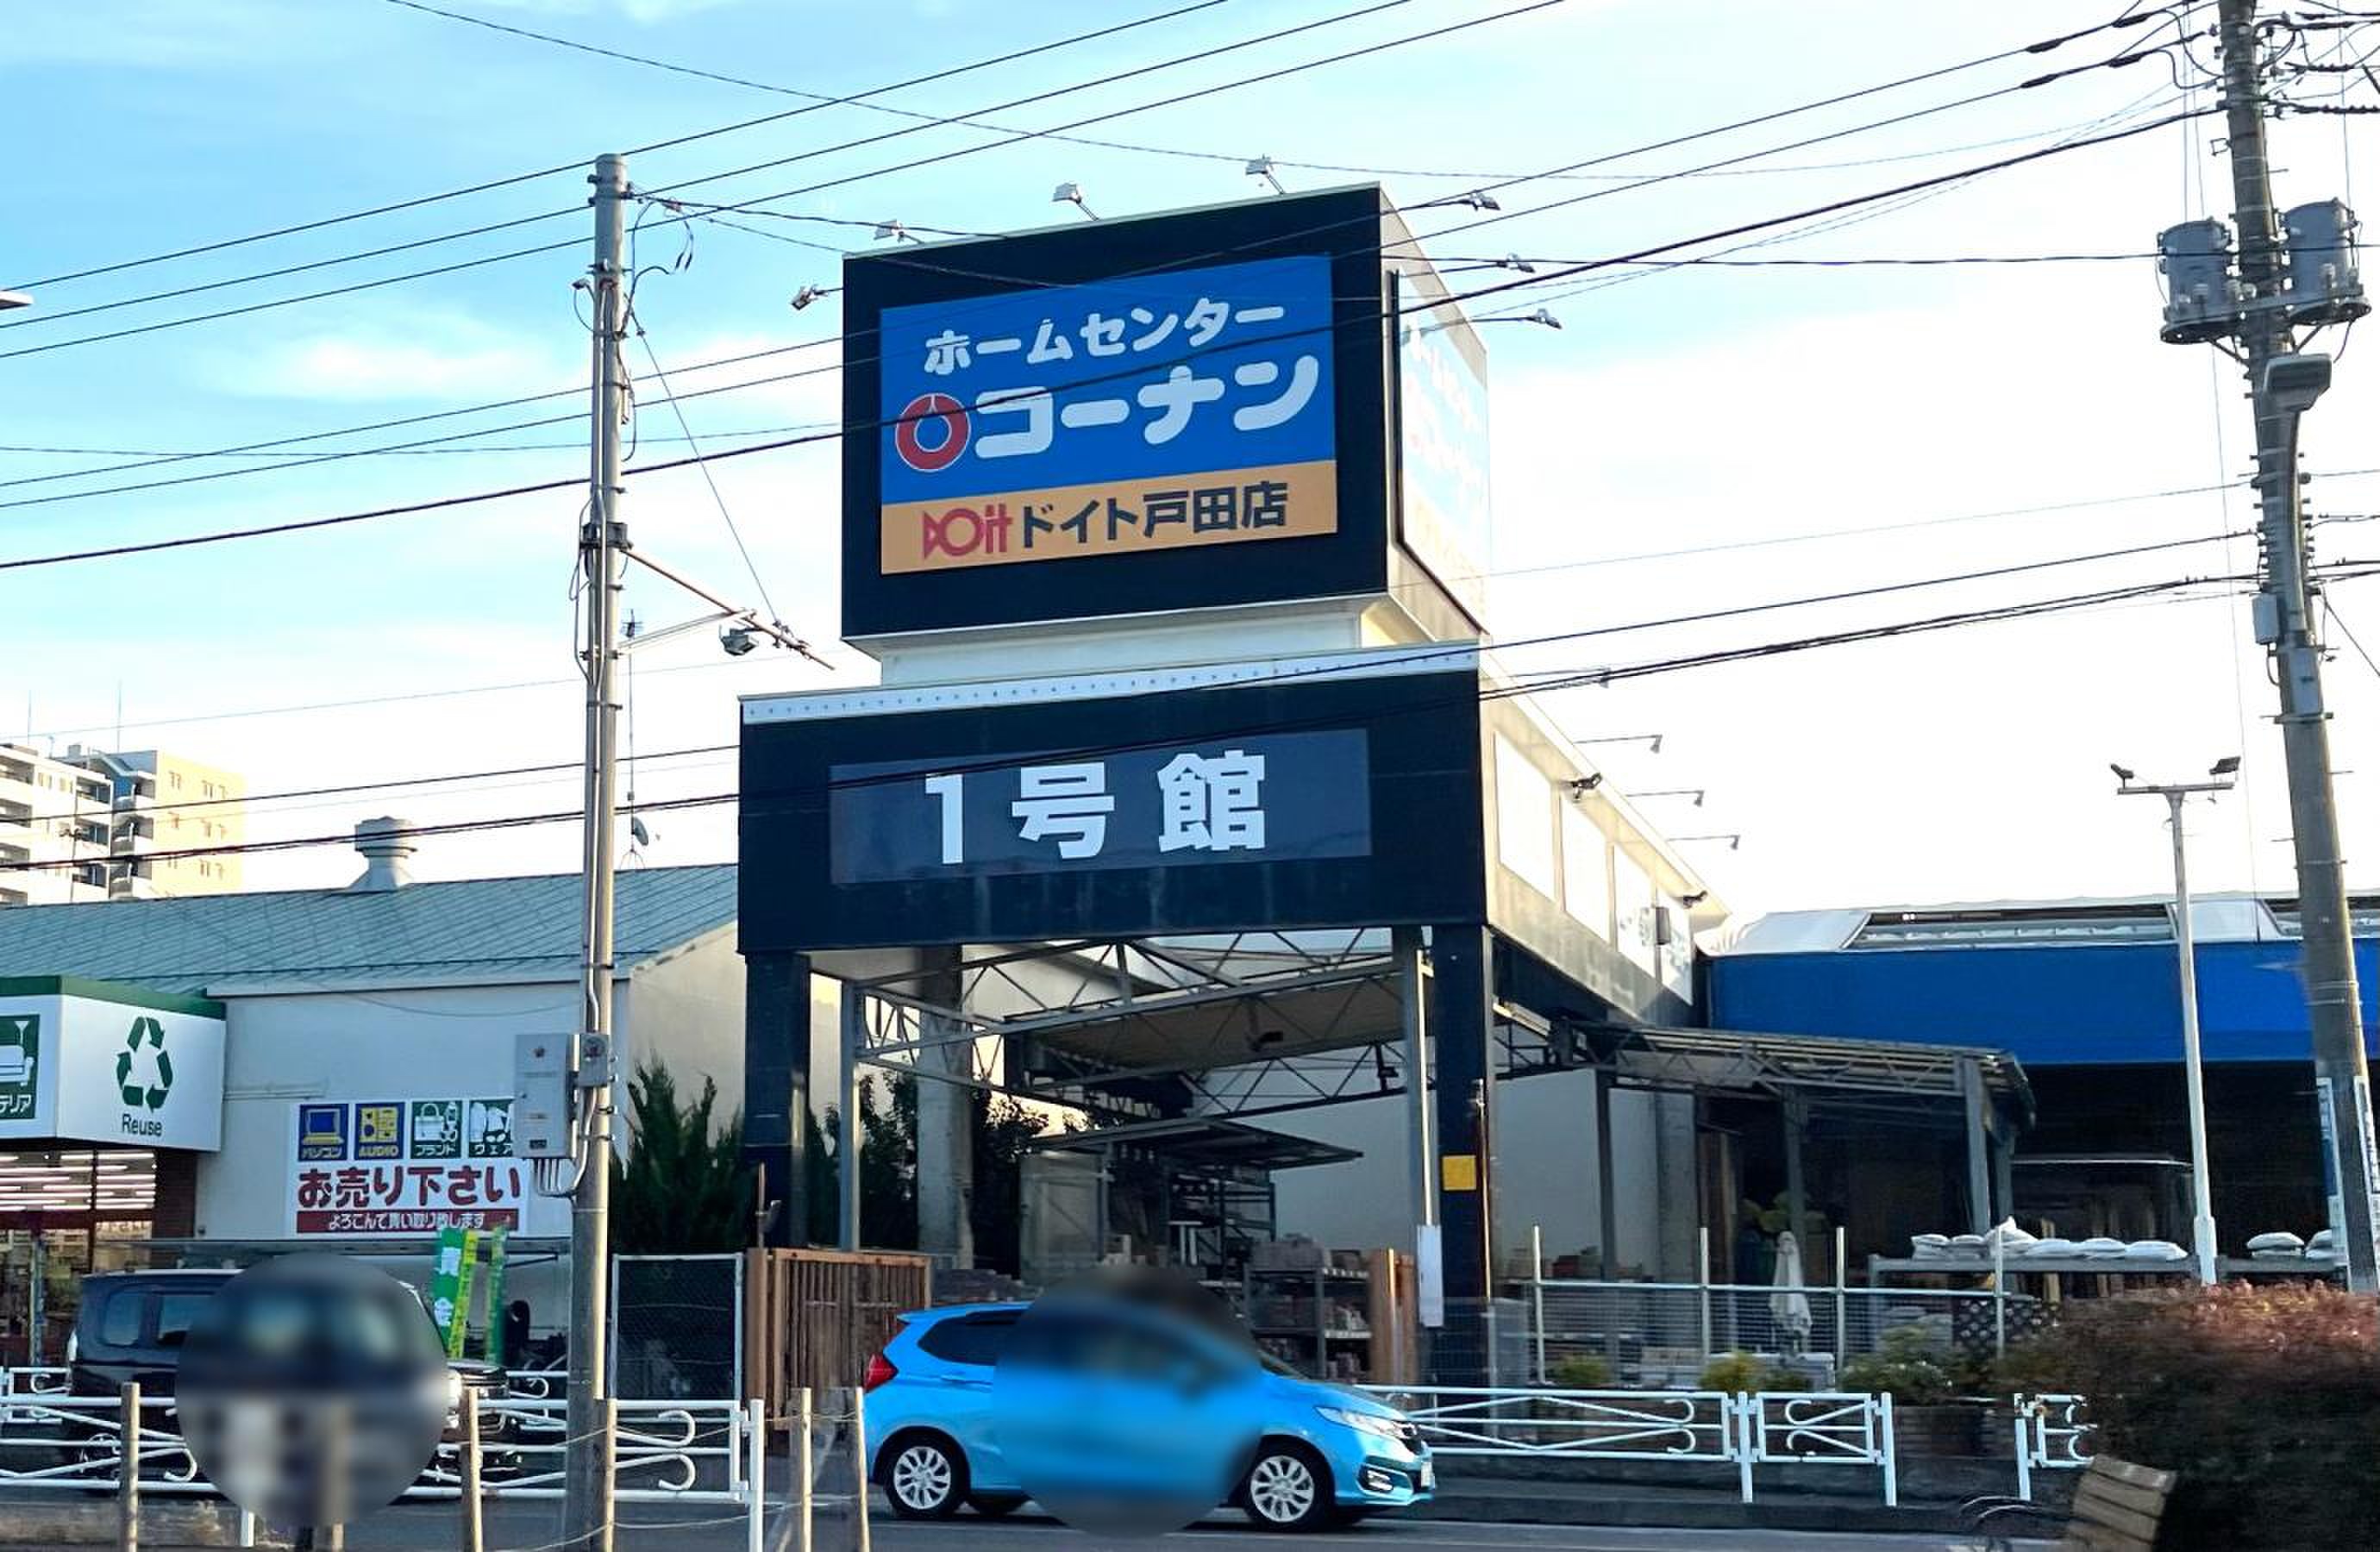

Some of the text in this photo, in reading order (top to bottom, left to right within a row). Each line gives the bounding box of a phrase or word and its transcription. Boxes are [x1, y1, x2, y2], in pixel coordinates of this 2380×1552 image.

[924, 297, 1285, 376] ホームセンター
[974, 354, 1319, 459] コーナン
[1023, 480, 1288, 548] ドイト戸田店
[122, 1113, 163, 1137] Reuse
[302, 1146, 342, 1160] パソコン
[359, 1144, 399, 1157] AUDIO
[414, 1143, 456, 1156] ブランド
[298, 1166, 521, 1208] お売り下さい
